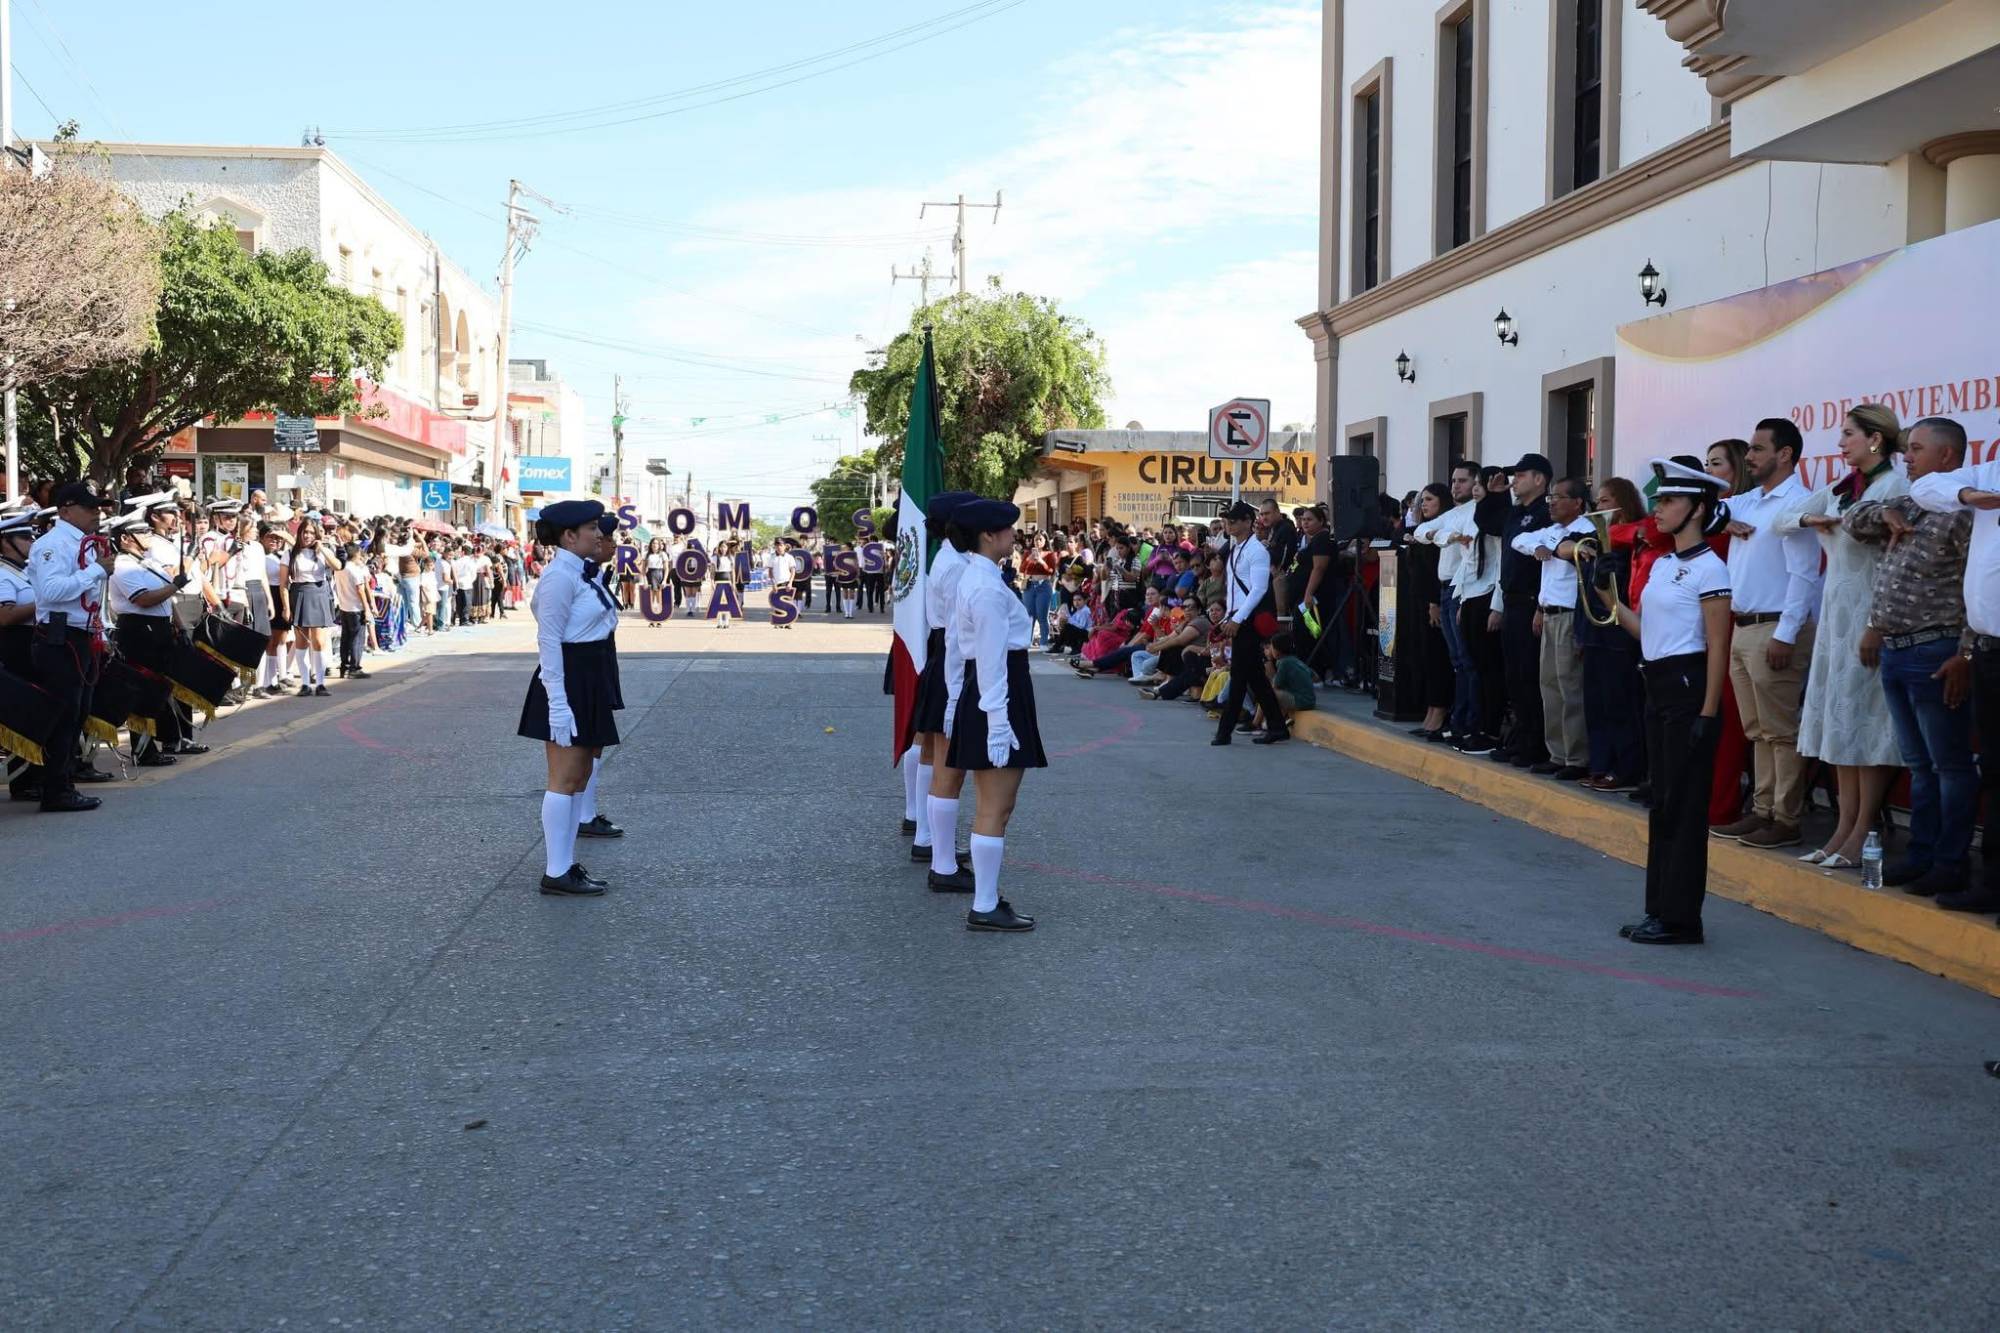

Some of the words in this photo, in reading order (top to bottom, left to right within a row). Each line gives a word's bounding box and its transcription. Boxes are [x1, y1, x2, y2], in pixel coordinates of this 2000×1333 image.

[1791, 404, 1815, 433] 20
[1823, 398, 1852, 430] DE
[1138, 454, 1316, 487] CIRUJAN
[639, 581, 799, 625] UAS
